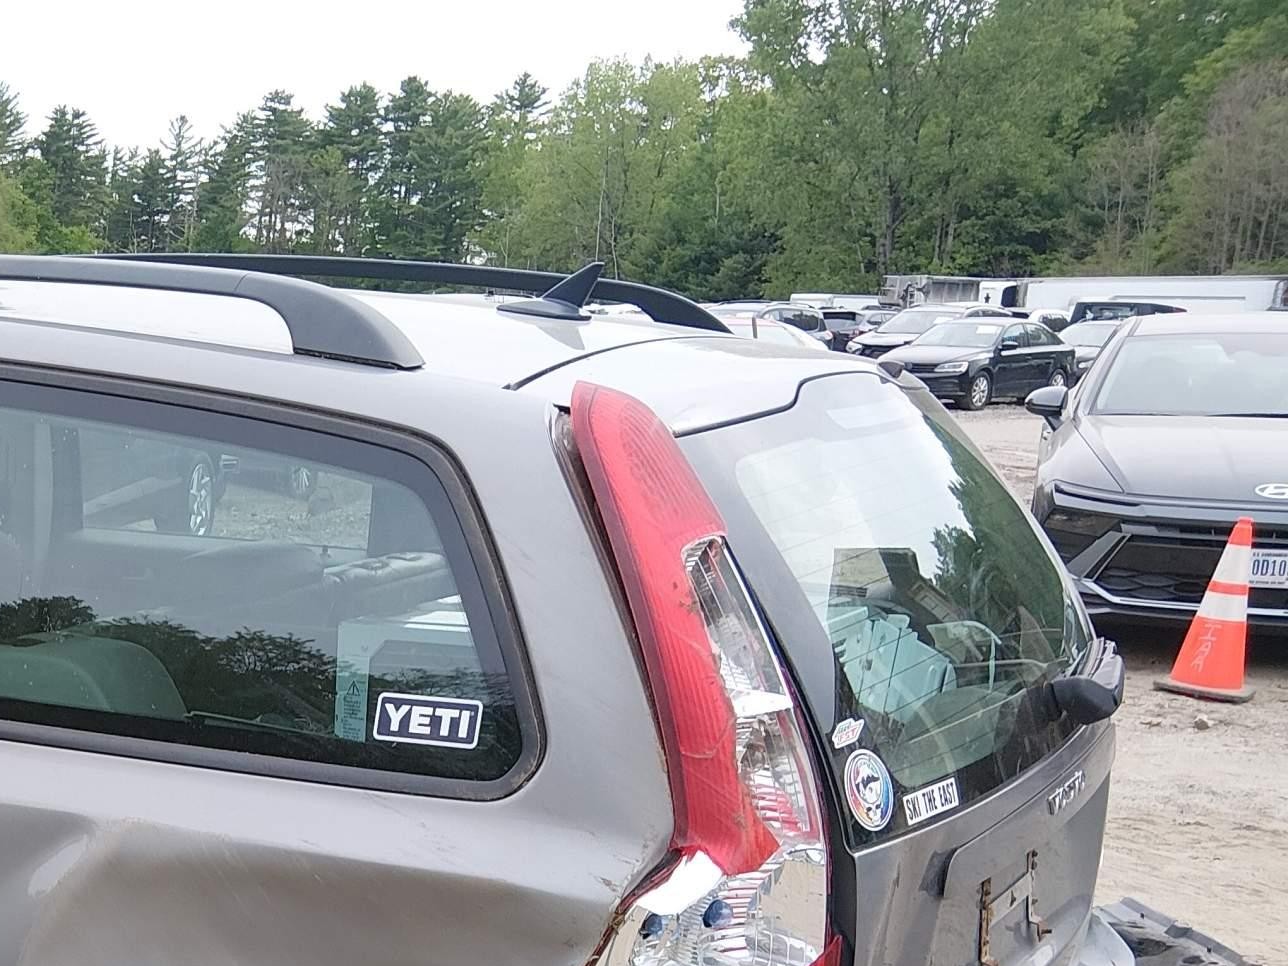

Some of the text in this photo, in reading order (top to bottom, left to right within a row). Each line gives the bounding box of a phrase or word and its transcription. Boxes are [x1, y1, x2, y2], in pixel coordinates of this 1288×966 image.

[384, 703, 472, 739] YETI
[905, 782, 956, 821] SKI THE EAST
